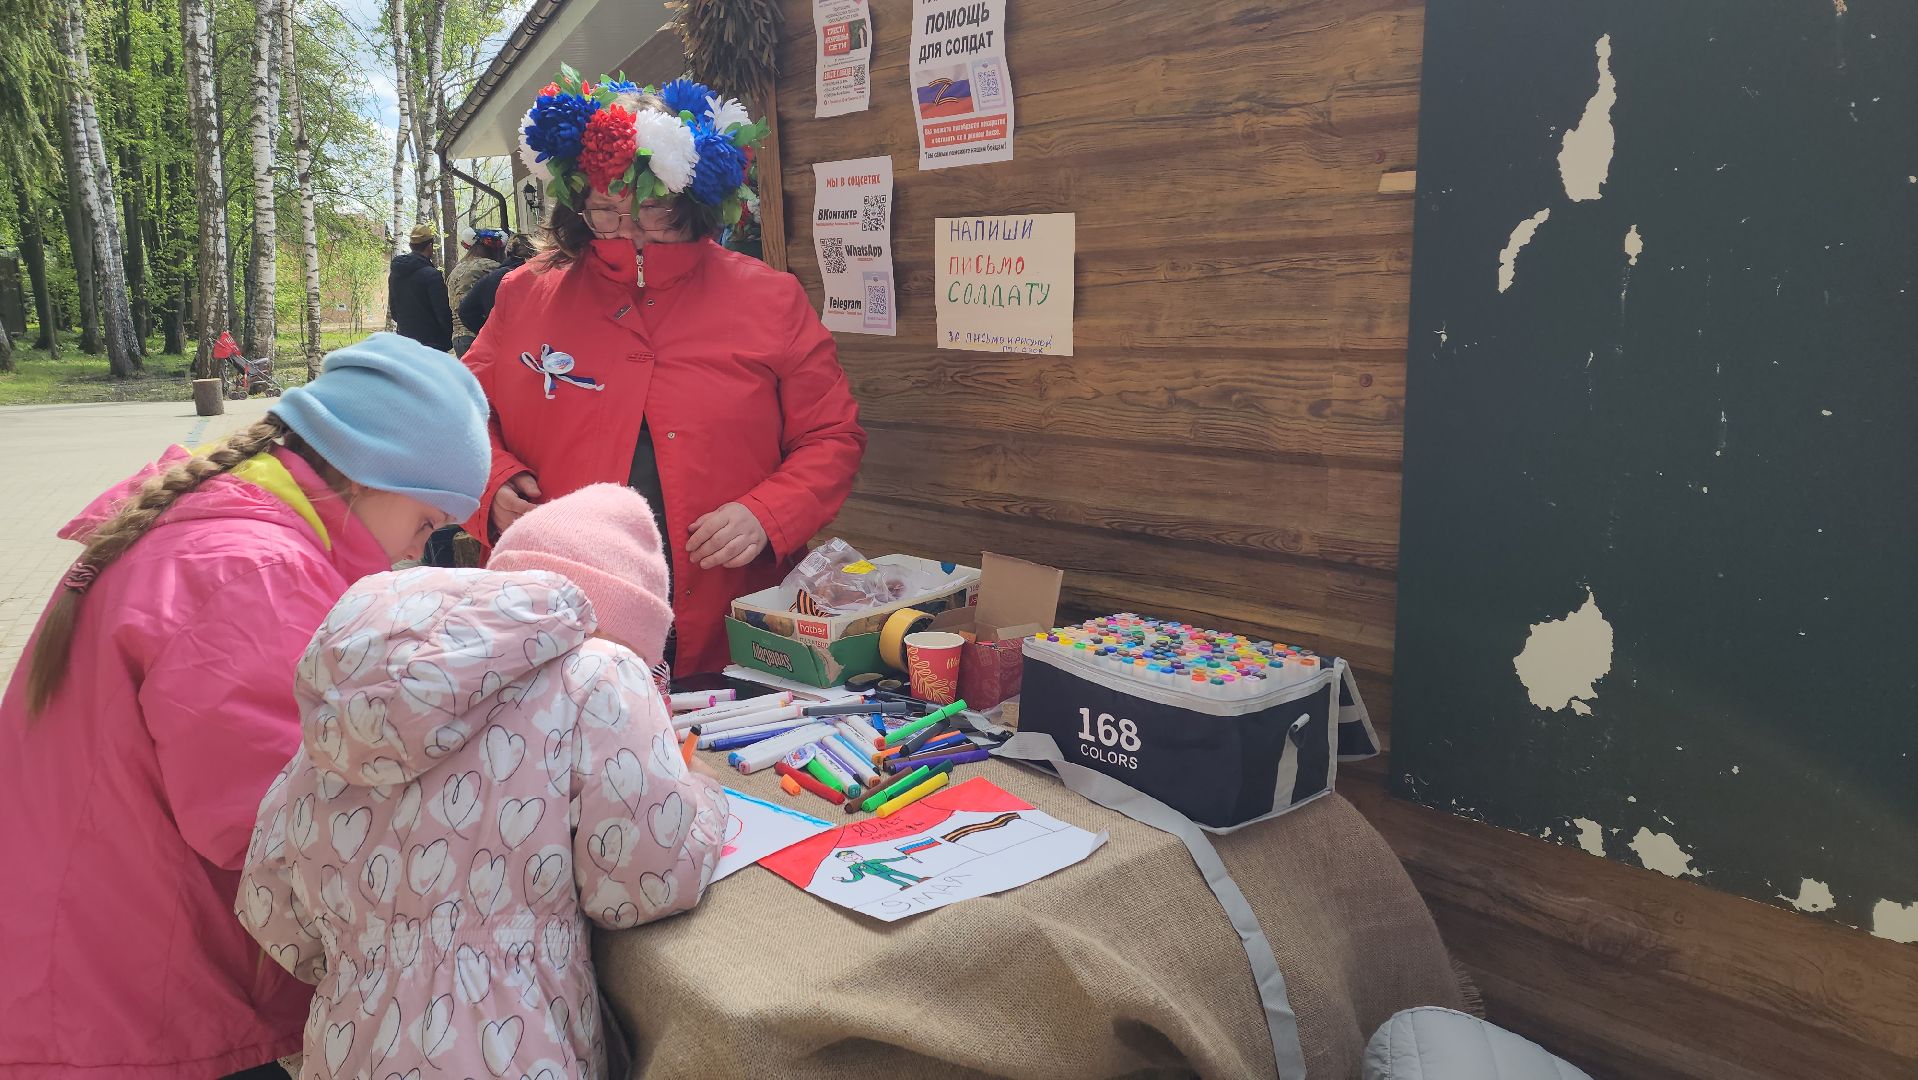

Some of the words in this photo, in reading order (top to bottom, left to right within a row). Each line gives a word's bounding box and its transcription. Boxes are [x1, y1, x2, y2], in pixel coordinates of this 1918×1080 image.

[925, 2, 989, 35] ПОМОЩЬ
[919, 42, 942, 64] ДЛЯ
[945, 30, 993, 56] СОЛДАТ
[826, 176, 838, 188] мы
[840, 177, 845, 187] в
[818, 208, 858, 221] ВКонтакте
[950, 219, 1033, 242] НАПИШИ
[845, 244, 883, 258] WhatsApp
[949, 254, 1025, 275] ПИСЬМО
[829, 296, 862, 310] Telegram
[948, 281, 1050, 308] СОЛДАТУ
[965, 332, 1005, 344] ПИСЬМО
[1078, 707, 1142, 752] 168
[1080, 743, 1138, 770] COLORS
